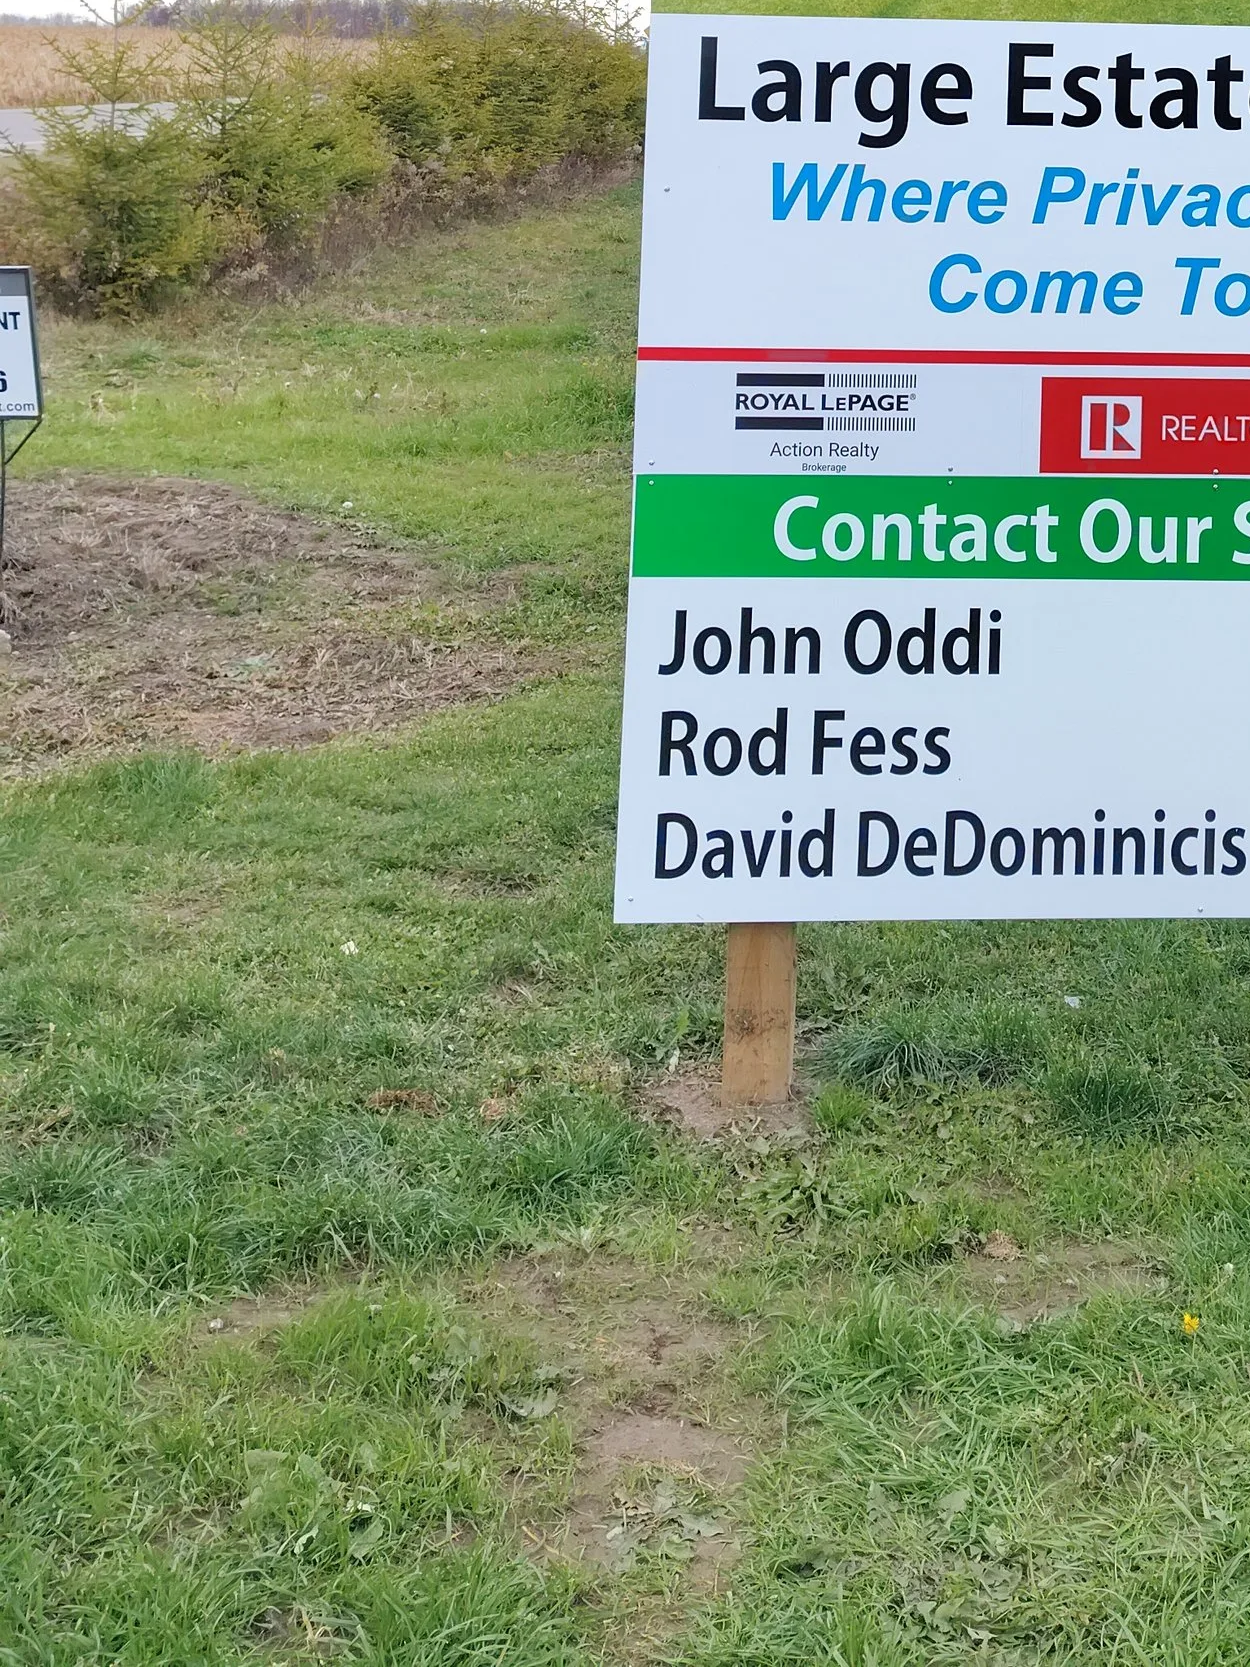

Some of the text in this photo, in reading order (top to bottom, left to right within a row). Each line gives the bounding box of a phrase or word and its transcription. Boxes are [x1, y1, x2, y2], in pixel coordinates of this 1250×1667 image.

[698, 36, 974, 149] Large
[772, 162, 1008, 225] Where
[928, 253, 1144, 316] Come
[0, 401, 35, 412] .com
[735, 393, 815, 411] ROYAL
[770, 441, 880, 461] Action Realty
[801, 462, 847, 474] Brokerage
[773, 495, 1060, 564] Contact
[1079, 498, 1212, 565] Our
[657, 606, 1002, 676] John Oddi
[658, 707, 951, 777] Rod Fess
[654, 808, 1247, 879] David DeDominicis
